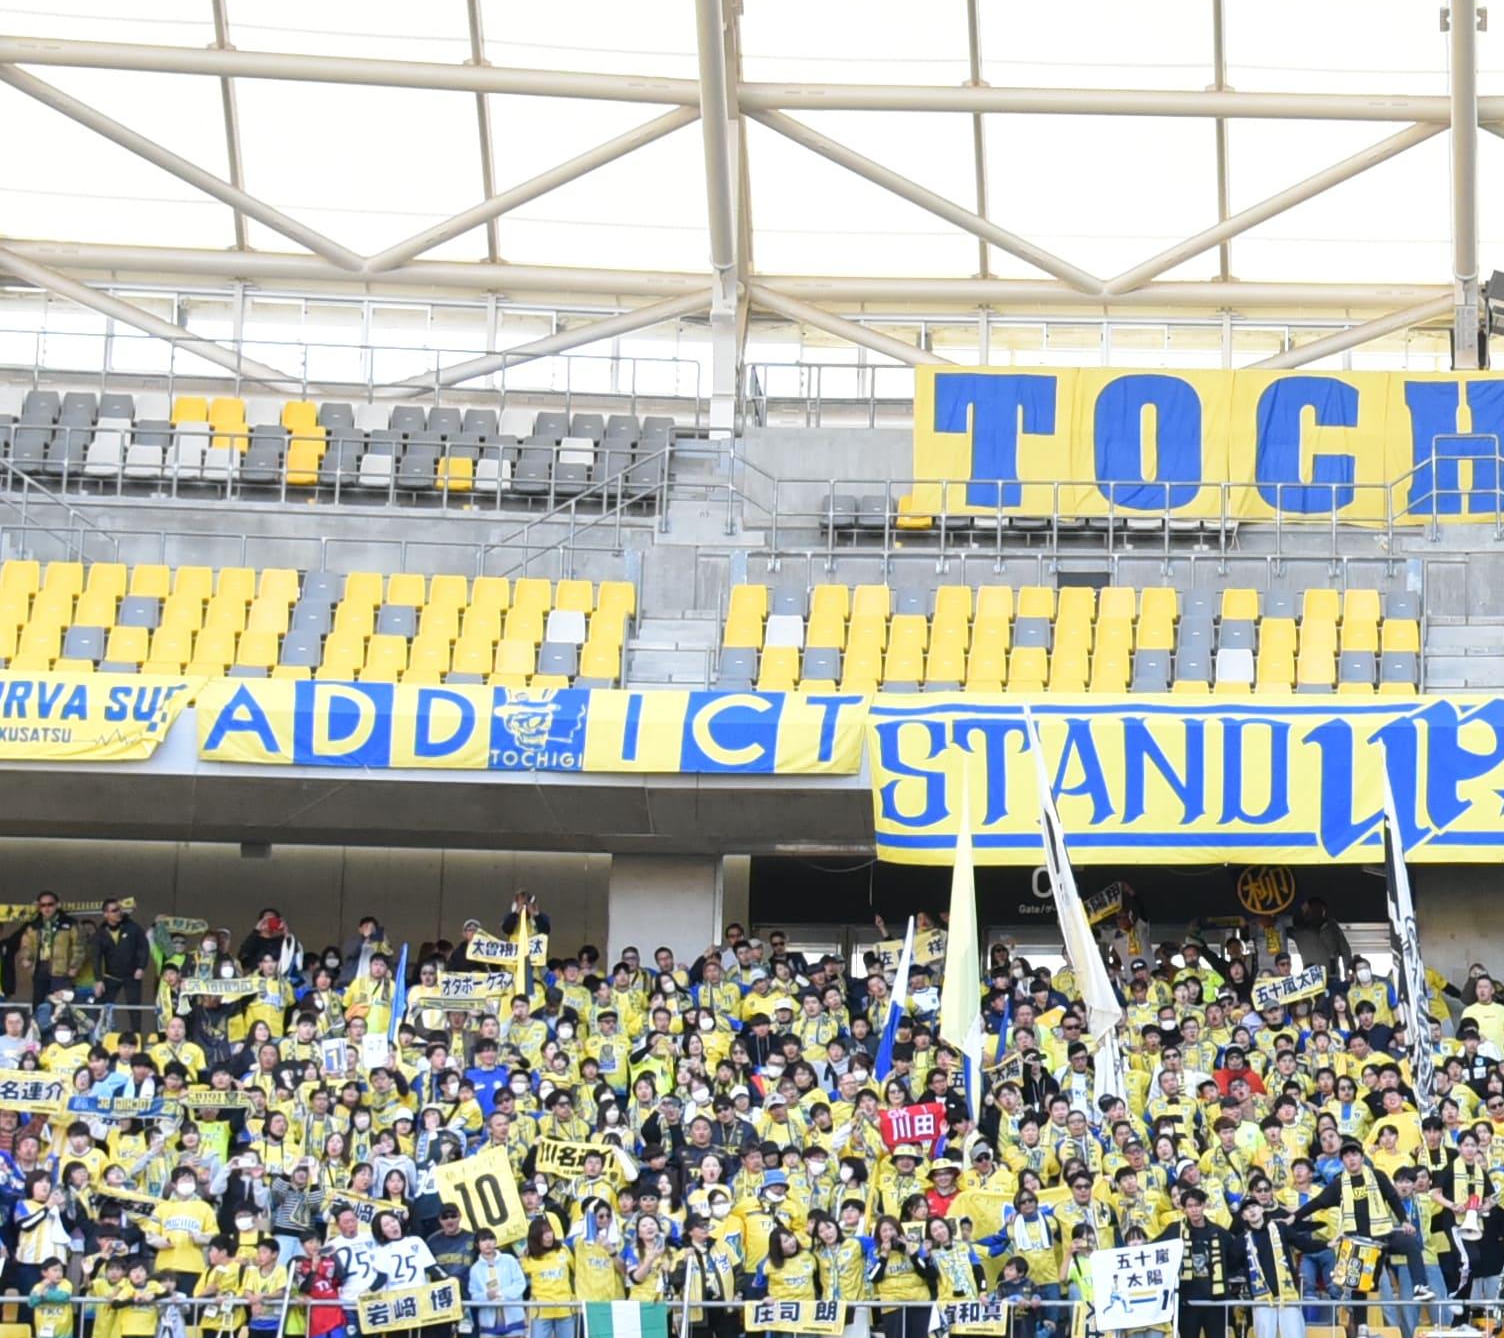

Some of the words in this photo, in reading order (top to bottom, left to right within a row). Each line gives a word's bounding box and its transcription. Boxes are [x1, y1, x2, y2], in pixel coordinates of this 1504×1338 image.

[489, 749, 583, 769] TOCHIGI
[874, 715, 1293, 827] STAND
[539, 1141, 615, 1169] 川名
[390, 1254, 417, 1283] 25
[1127, 1269, 1164, 1289] 太陽
